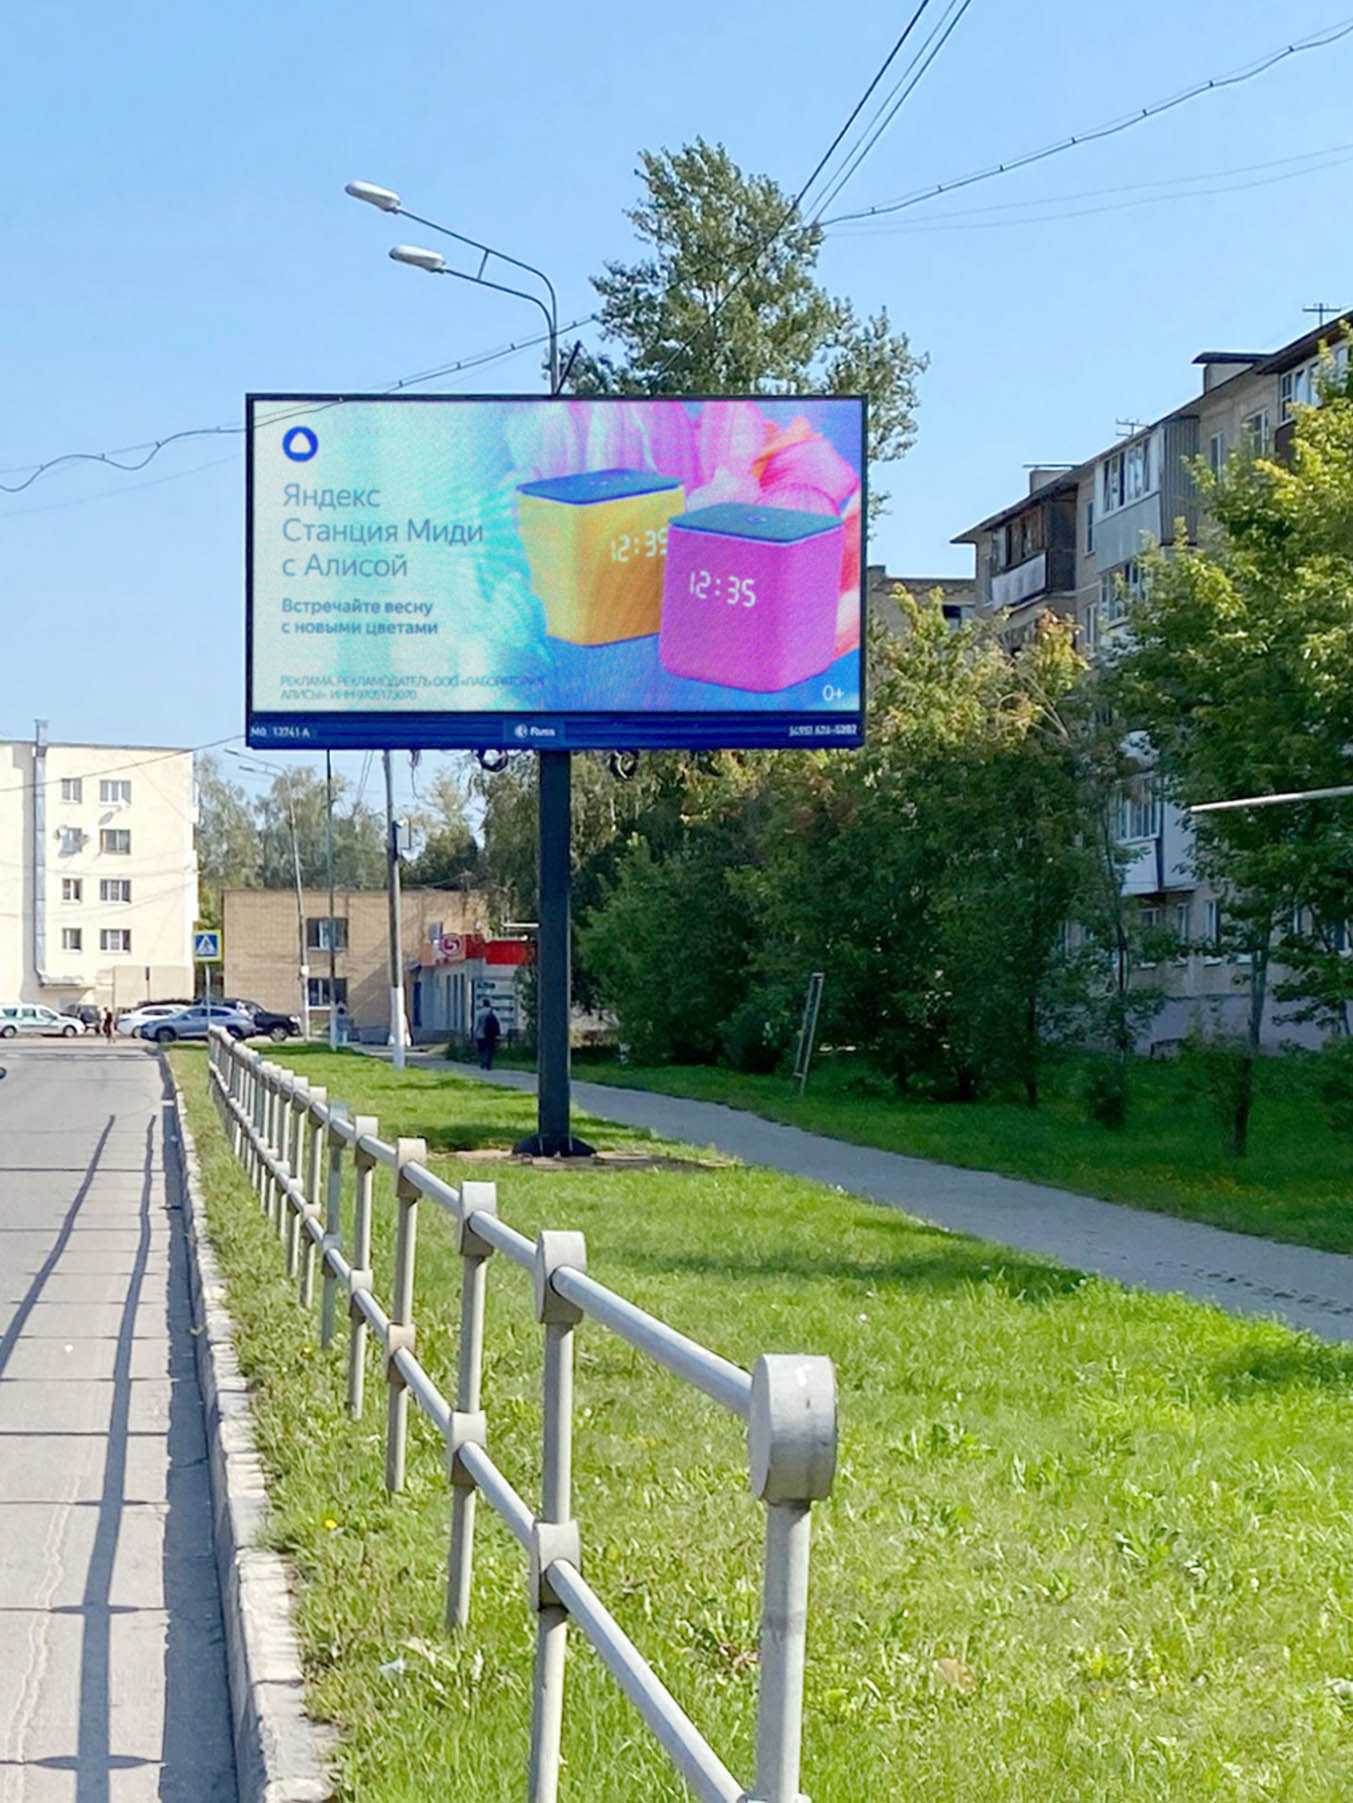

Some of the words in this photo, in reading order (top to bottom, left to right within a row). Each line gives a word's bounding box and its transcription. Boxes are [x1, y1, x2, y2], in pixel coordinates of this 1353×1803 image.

[282, 483, 382, 511] Яндекс
[282, 517, 398, 546] Станция
[407, 518, 483, 547] Миди
[282, 558, 297, 576] с
[304, 553, 408, 577] Алисой
[690, 570, 756, 608] 12:35
[281, 598, 381, 615] Встречайте
[384, 601, 433, 617] весну
[281, 622, 290, 634] с
[295, 622, 361, 634] новыми
[365, 622, 438, 636] цветами
[822, 684, 844, 702] 0+
